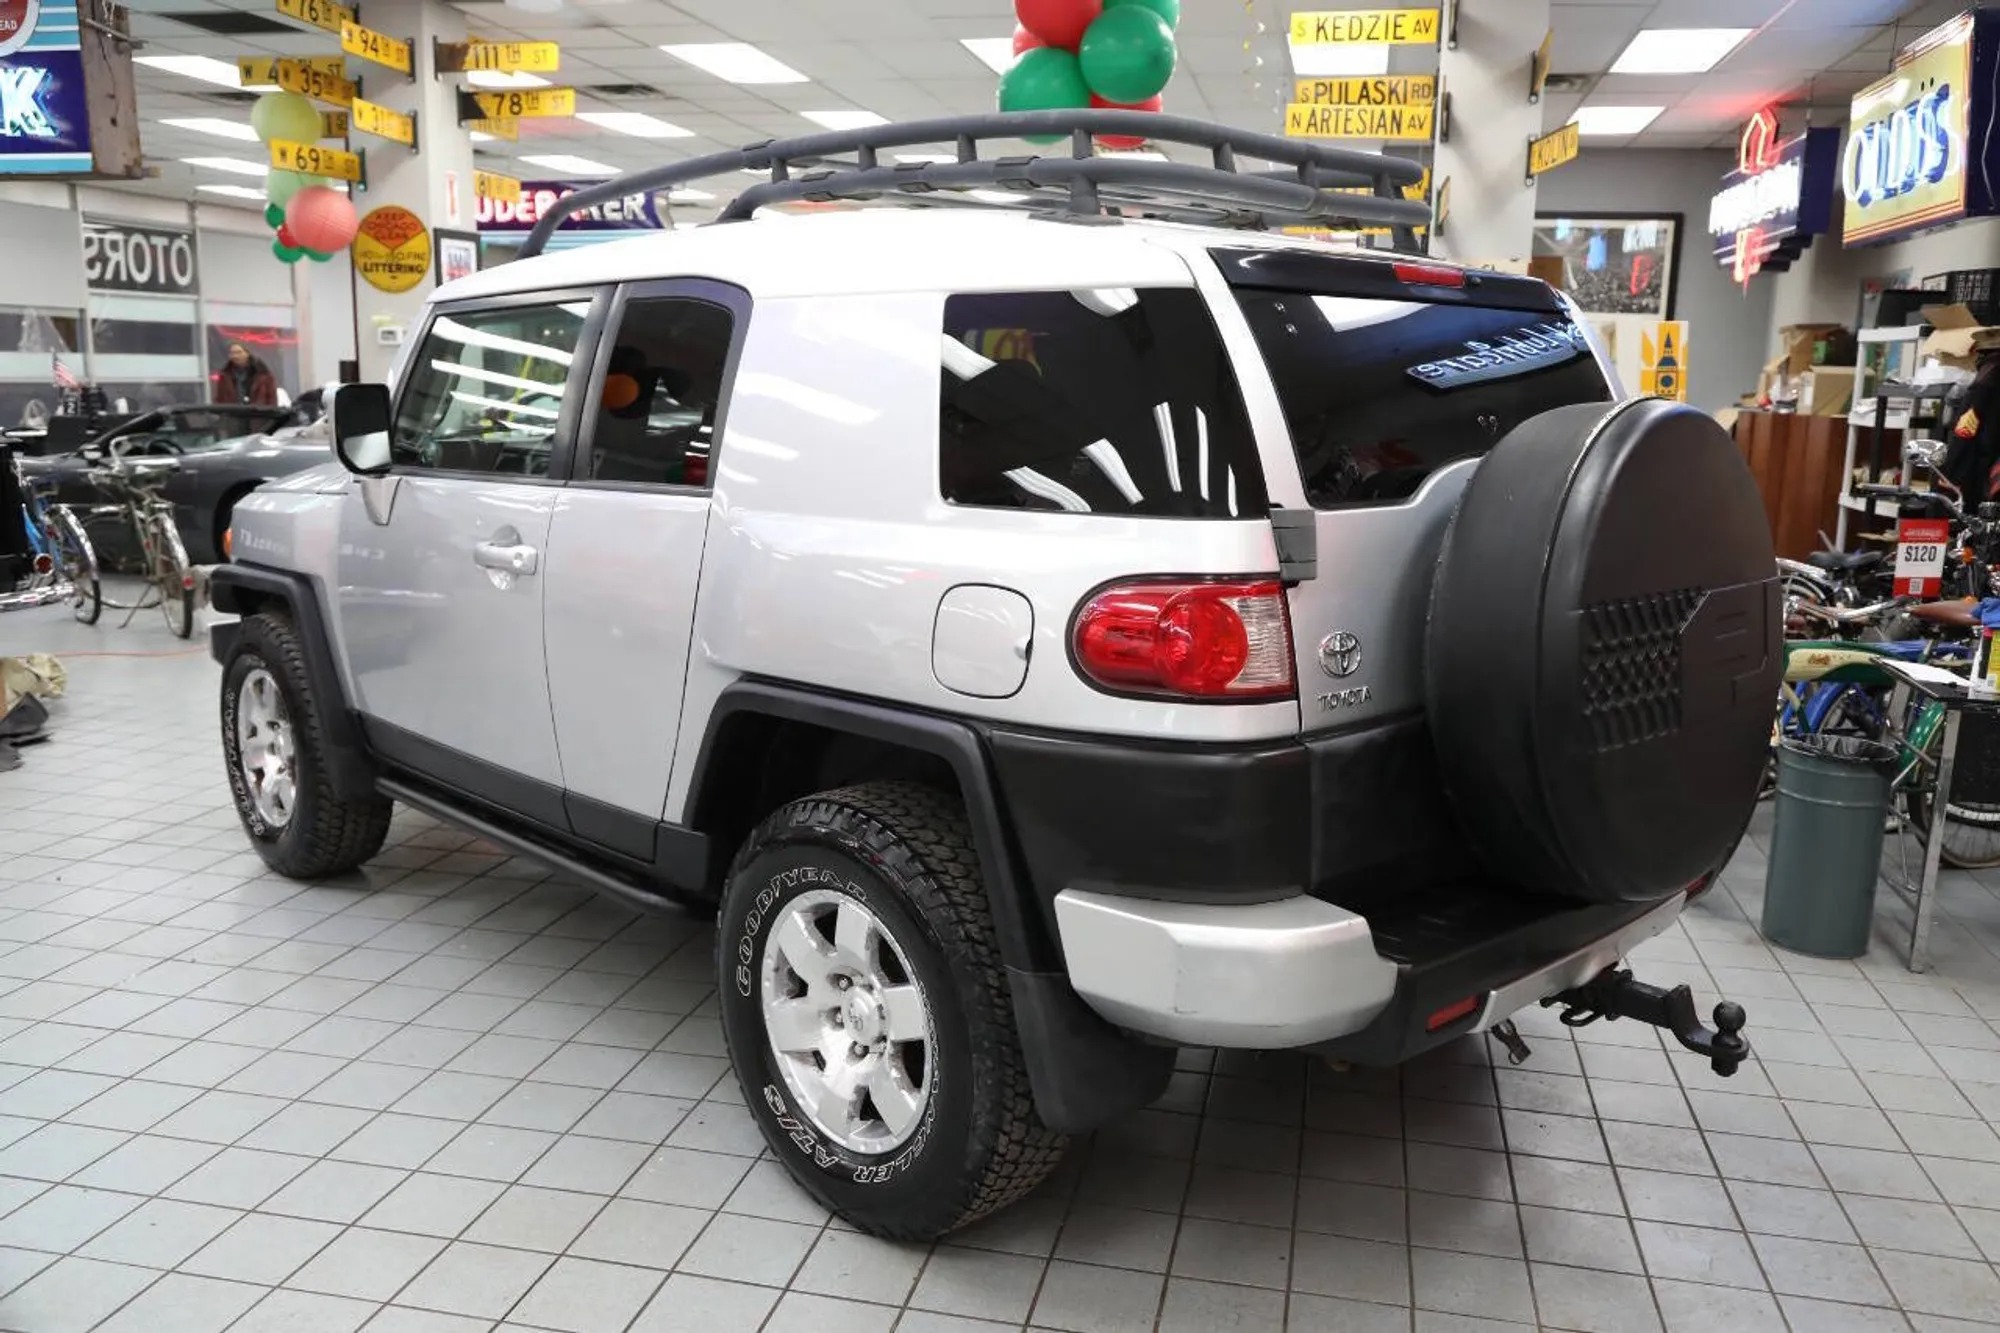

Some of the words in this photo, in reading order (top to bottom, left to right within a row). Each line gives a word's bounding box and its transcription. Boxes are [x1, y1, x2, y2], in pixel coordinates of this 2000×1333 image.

[1296, 20, 1306, 37] S
[1315, 14, 1407, 42] KEDZIE
[1413, 18, 1433, 34] AV
[360, 29, 380, 56] 94
[300, 68, 322, 97] 35
[1301, 88, 1311, 103] S
[1313, 80, 1408, 106] PULASKI
[1412, 83, 1431, 99] RD
[491, 92, 523, 116] 78
[1291, 112, 1302, 128] N
[1306, 108, 1403, 135] ARTESIAN
[1408, 114, 1427, 130] AV
[1843, 84, 1961, 207] OLDS
[295, 146, 320, 172] 69
[363, 261, 424, 274] LITTERING
[1318, 686, 1372, 711] TOYOTA
